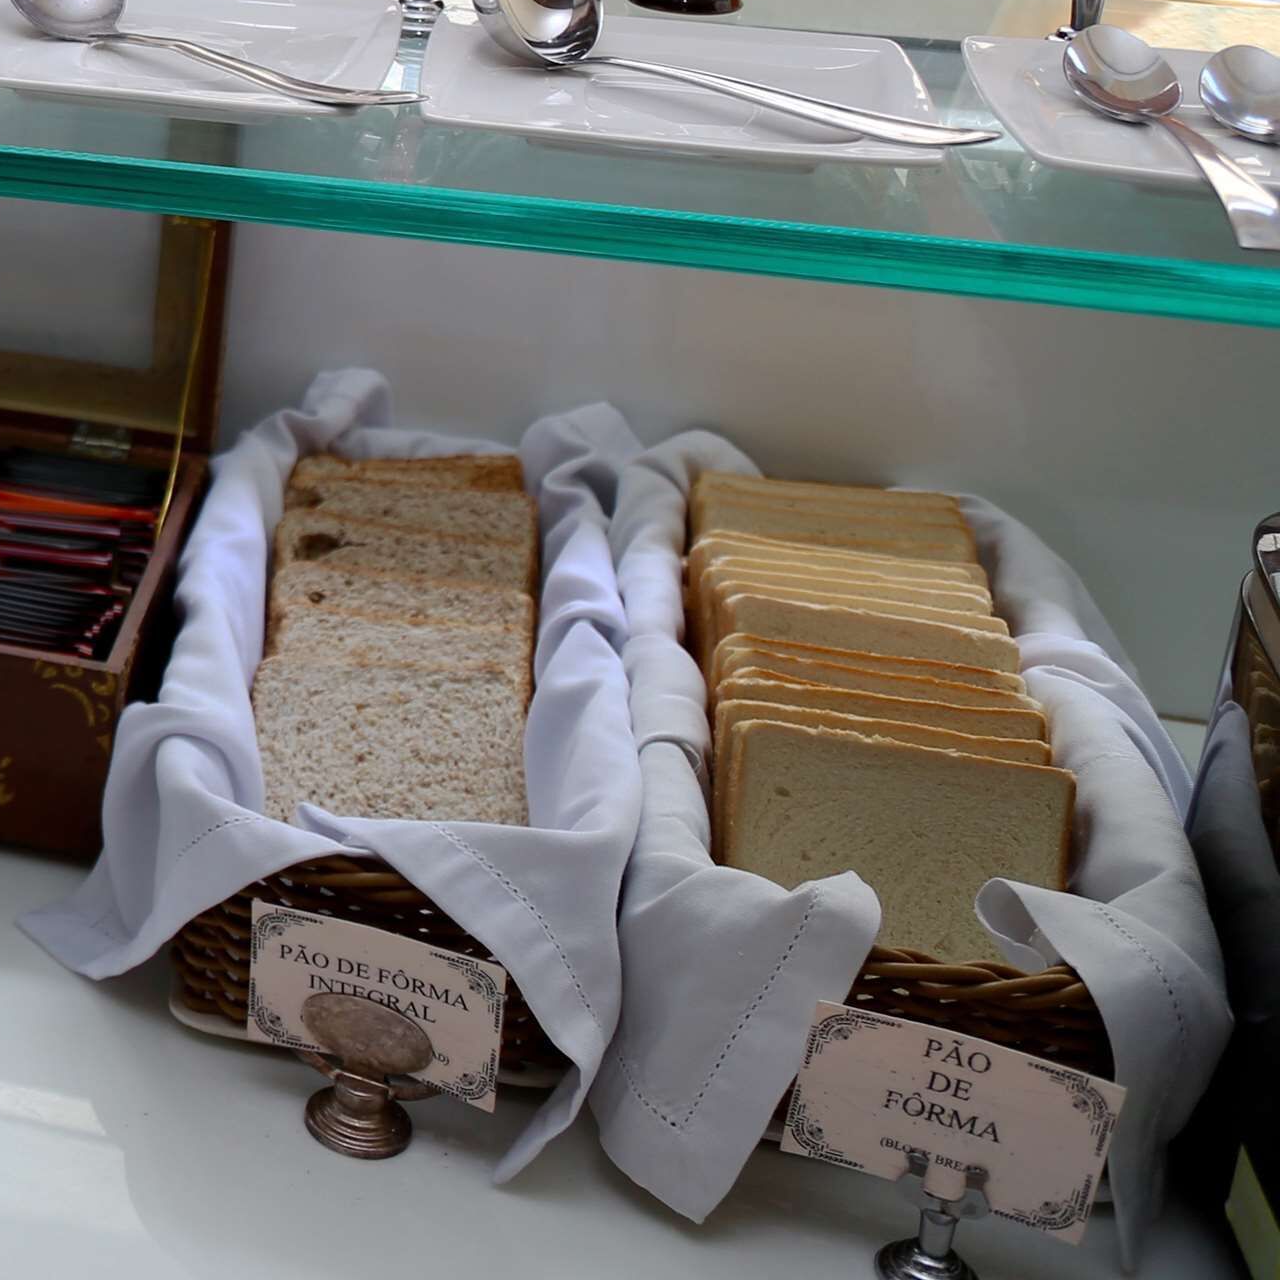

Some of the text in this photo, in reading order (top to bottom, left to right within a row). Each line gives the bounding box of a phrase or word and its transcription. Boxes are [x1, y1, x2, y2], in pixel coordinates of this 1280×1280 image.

[279, 943, 470, 1012] PÃO DE FÔRMA
[308, 974, 437, 1024] INTEGRAL
[923, 1038, 992, 1074] PÃO
[926, 1070, 973, 1101] DE
[883, 1089, 1001, 1143] FÔRMA
